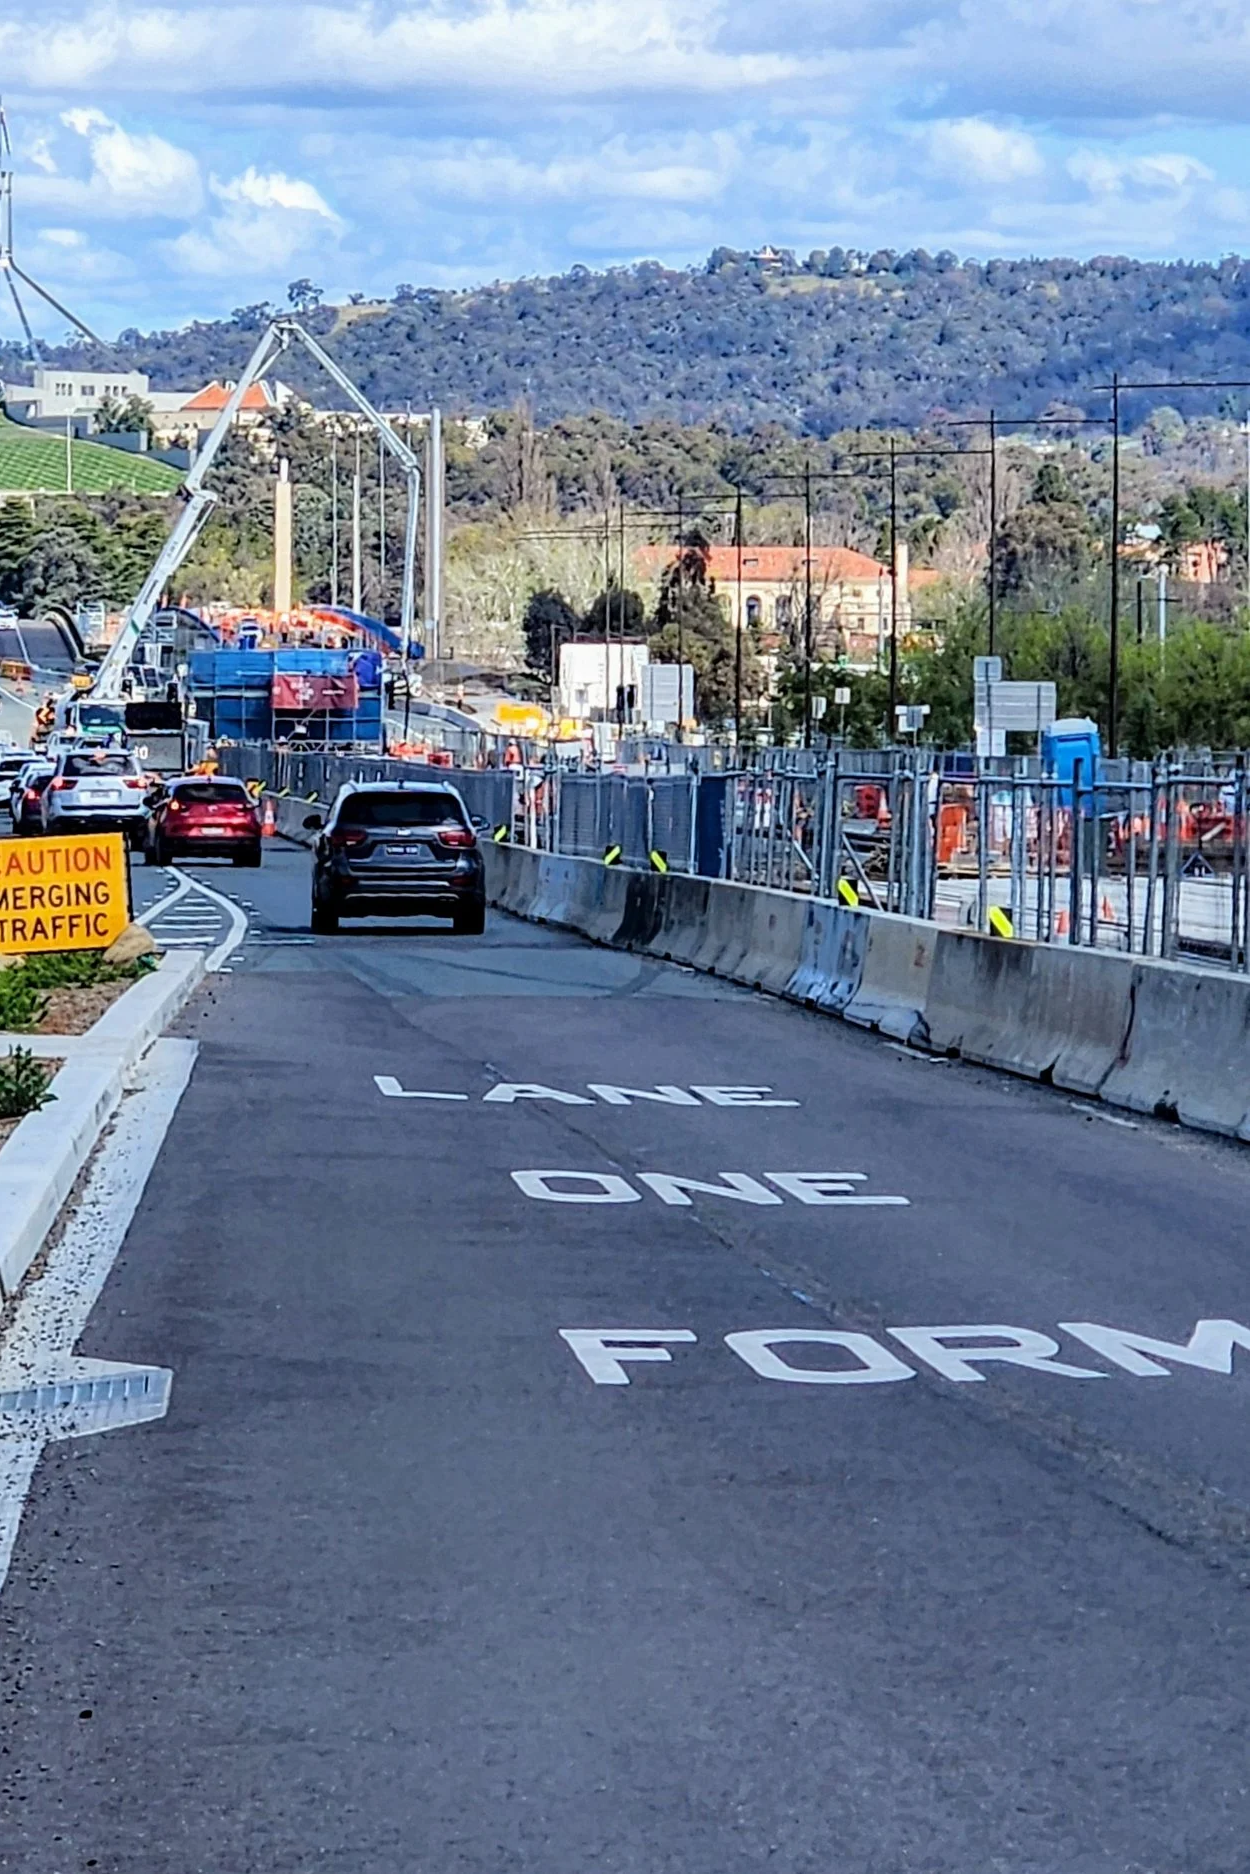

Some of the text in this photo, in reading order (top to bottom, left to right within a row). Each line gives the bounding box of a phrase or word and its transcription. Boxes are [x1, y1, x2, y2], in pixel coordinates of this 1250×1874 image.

[373, 1075, 801, 1108] LANE
[510, 1169, 910, 1206] ONE
[558, 1319, 1250, 1385] FORM
